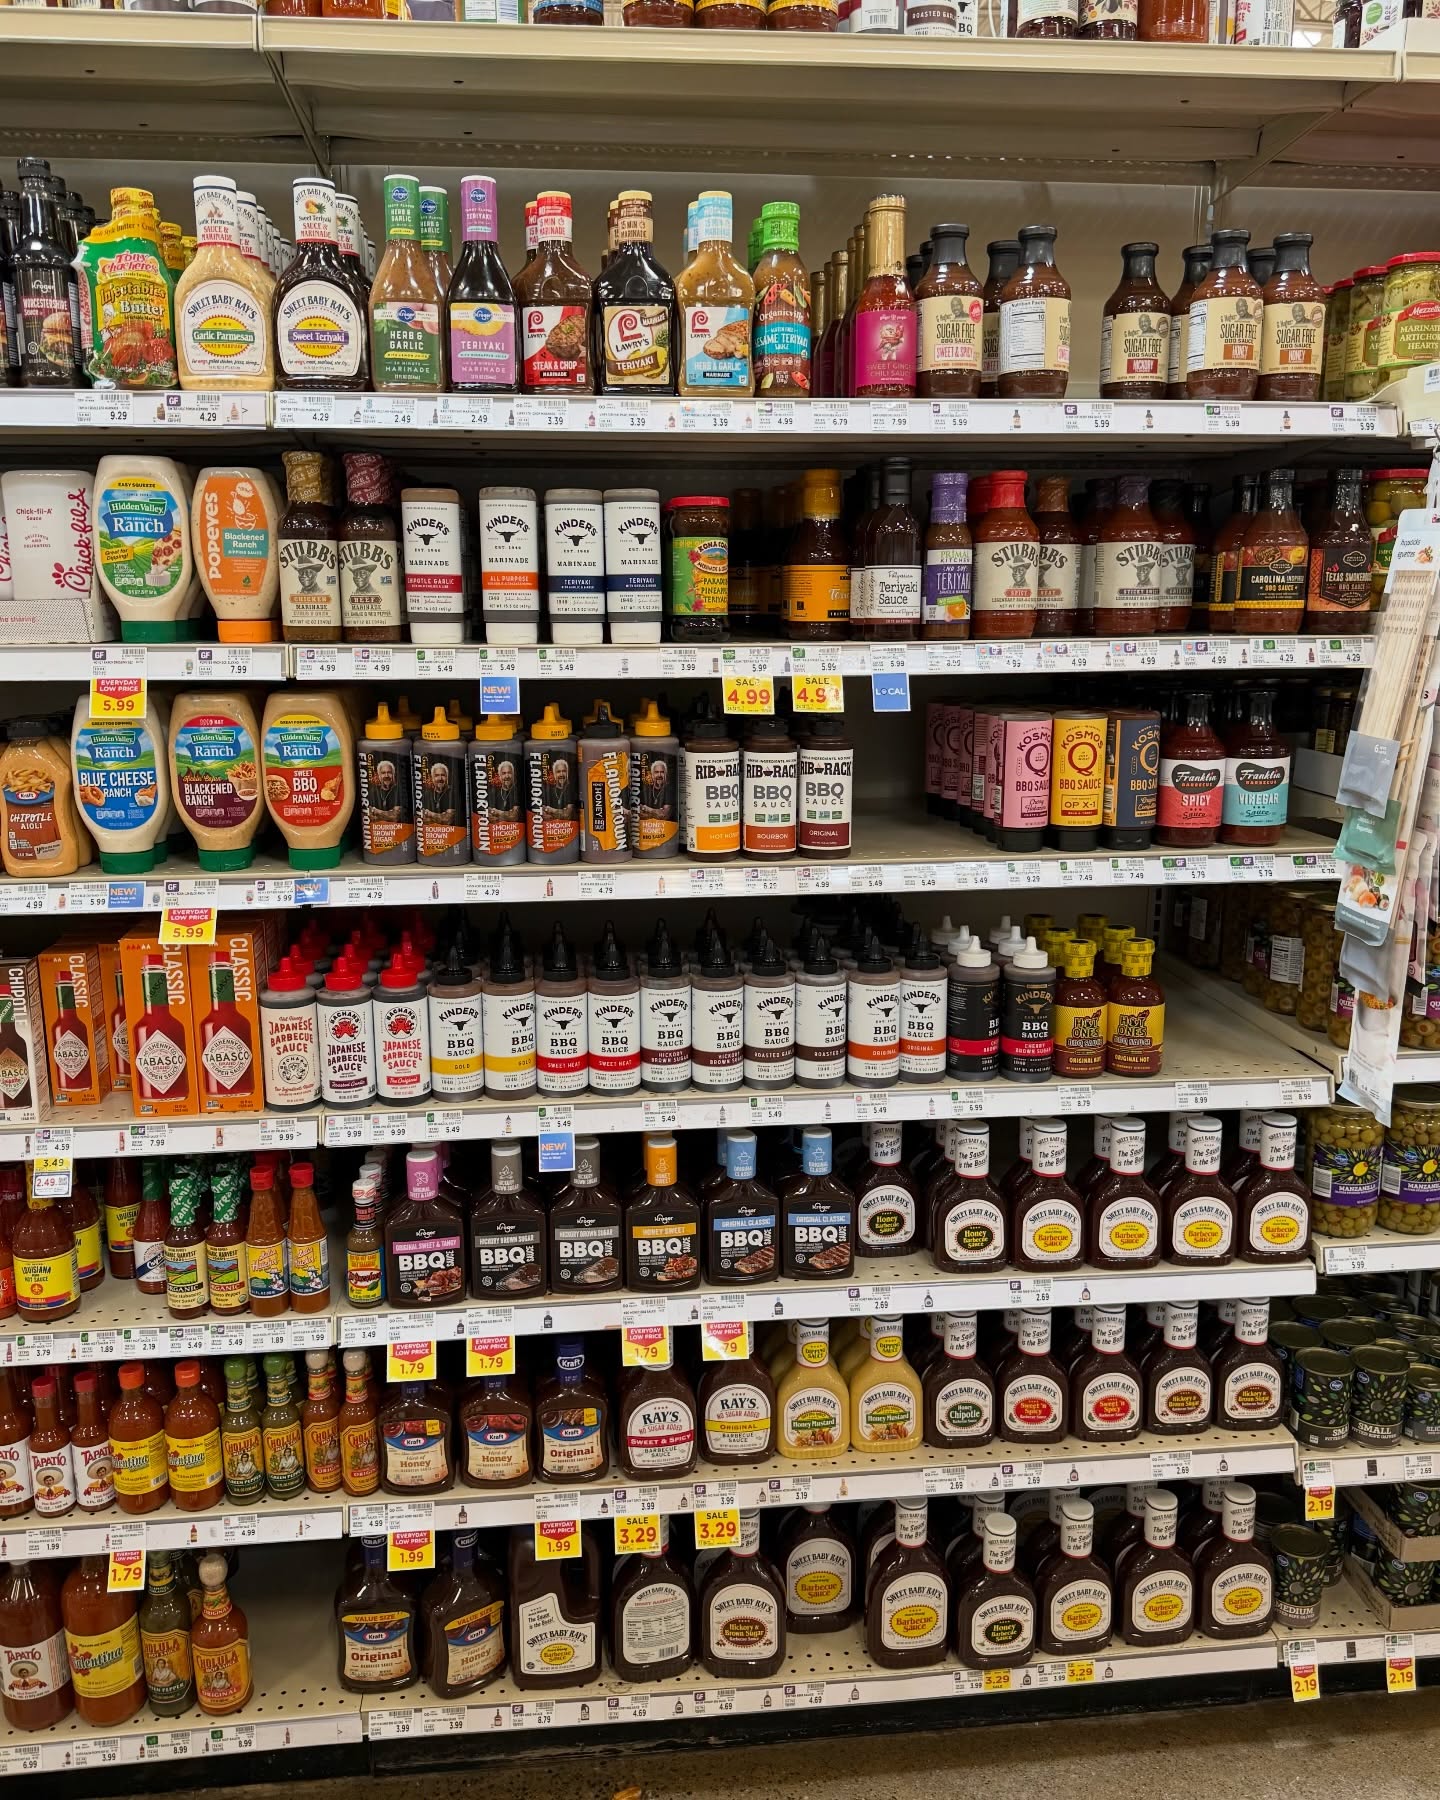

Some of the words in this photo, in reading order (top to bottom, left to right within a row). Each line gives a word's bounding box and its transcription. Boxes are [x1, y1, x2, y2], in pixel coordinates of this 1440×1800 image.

[912, 10, 943, 20] ROASTED
[100, 281, 167, 306] Injectables
[23, 298, 67, 310] WORCESTERSHIRE
[120, 301, 164, 316] Butter
[188, 297, 211, 319] SWEET
[212, 295, 234, 306] BABY
[233, 299, 256, 321] RAY'S
[284, 298, 306, 319] SWEET
[307, 295, 329, 306] BABY
[329, 299, 352, 321] RAY'S
[193, 331, 217, 341] Garlic
[218, 331, 254, 342] Parmesan
[390, 331, 414, 340] HERB
[416, 332, 423, 340] &
[936, 323, 960, 340] SUGAR
[961, 322, 976, 339] FREE
[293, 332, 313, 342] Sweet
[314, 331, 346, 343] Teriyaki
[390, 341, 424, 350] GARLIC
[460, 342, 505, 352] TERIYAKI
[615, 339, 650, 352] LAWRY'S
[1407, 341, 1438, 350] HEARTS
[533, 361, 552, 371] STEAK
[553, 361, 559, 370] &
[560, 361, 578, 371] CHOP
[615, 356, 655, 371] TERIYAKI
[694, 361, 714, 371] HERB
[721, 362, 742, 372] GARLIC
[385, 366, 430, 374] MARINADE
[462, 366, 506, 374] MARINADE
[110, 411, 127, 421] 9.29
[200, 412, 217, 422] 4.29
[394, 415, 411, 424] 2.49
[547, 416, 564, 425] 3.39
[1360, 422, 1375, 430] 5.99
[111, 501, 139, 514] Hidden
[139, 502, 165, 514] Valley
[113, 517, 165, 534] Ranch
[406, 517, 450, 536] KINDER'S
[485, 514, 529, 534] KINDER'S
[224, 532, 264, 541] Blackened
[233, 540, 257, 549] Ranch
[280, 541, 337, 569] STUBB'S
[488, 556, 529, 564] MARINADE
[409, 559, 449, 567] MARINADE
[1251, 575, 1286, 584] CAROLINA
[1325, 571, 1344, 582] TEXAS
[880, 581, 918, 597] Teriyaki
[879, 593, 908, 605] Sauce
[1280, 653, 1294, 662] 4.29
[230, 665, 247, 674] 7.99
[805, 677, 830, 685] SALE
[483, 685, 511, 695] NEW!
[876, 687, 906, 696] LOCAL
[727, 689, 770, 705] 4.99
[103, 700, 135, 712] 5.99
[92, 733, 113, 744] Hidden
[114, 732, 133, 744] Valley
[95, 746, 135, 758] Ranch
[1068, 742, 1097, 776] Q
[293, 769, 313, 777] SWEET
[800, 761, 815, 776] RIB
[823, 761, 852, 777] RACK
[80, 771, 107, 787] BLUE
[109, 770, 156, 786] CHEESE
[1176, 770, 1217, 783] Franklin
[184, 782, 232, 795] BLACKENED
[292, 776, 318, 792] BBQ
[805, 781, 844, 797] BBQ
[1060, 779, 1075, 790] BBQ
[1077, 778, 1101, 790] SAUCE
[104, 786, 132, 798] RANCH
[185, 793, 214, 806] RANCH
[292, 793, 320, 804] RANCH
[805, 797, 844, 806] SAUCE
[1182, 795, 1210, 806] SPICY
[1239, 793, 1279, 805] VINEGAR
[1064, 801, 1079, 809] OP
[1082, 801, 1096, 809] X-1
[10, 812, 53, 824] CHIPOTLE
[20, 821, 43, 830] AIOLI
[757, 832, 788, 840] BOURBON
[809, 829, 838, 837] ORIGINAL
[1192, 870, 1206, 879] 5.79
[367, 891, 382, 900] 4.79
[26, 900, 43, 909] 4.99
[173, 927, 204, 938] 5.99
[229, 937, 252, 1002] CLASSIC
[438, 1006, 479, 1022] KINDER'S
[595, 1005, 635, 1018] KINDER'S
[268, 1017, 312, 1036] JAPANESE
[907, 1020, 934, 1031] BBQ
[270, 1033, 313, 1048] BARBECUE
[447, 1037, 474, 1048] BBQ
[601, 1036, 628, 1046] BBQ
[276, 1043, 308, 1056] SAUCE
[447, 1048, 475, 1057] SAUCE
[907, 1044, 933, 1052] ORIGINAL
[138, 1055, 184, 1067] TABASCO
[204, 1051, 250, 1062] TABASCO
[969, 1104, 983, 1112] 6.99
[661, 1114, 676, 1122] 5.49
[150, 1139, 165, 1147] 7.99
[43, 1158, 64, 1168] 3.49
[795, 1226, 839, 1243] BBQ
[965, 1230, 987, 1239] Honey
[1038, 1234, 1069, 1242] Barbecue
[638, 1238, 682, 1256] BBQ
[1044, 1240, 1063, 1248] Sauce
[400, 1252, 446, 1271] BBQ
[480, 1247, 526, 1265] BBQ
[21, 1264, 52, 1275] LOUISIANA
[1351, 1260, 1365, 1269] 5.99
[875, 1301, 889, 1310] 2.69
[400, 1363, 425, 1375] 1.79
[720, 1397, 757, 1410] RAY'S
[949, 1409, 980, 1419] Chipotle
[793, 1420, 813, 1430] Honey
[814, 1419, 836, 1428] Mustard
[1357, 1422, 1392, 1435] SMALL
[550, 1446, 595, 1459] Original
[482, 1454, 512, 1465] Honey
[1307, 1499, 1333, 1512] 2.19
[706, 1511, 728, 1519] SALE
[619, 1527, 657, 1544] 3.29
[800, 1583, 838, 1592] Barbecue
[808, 1589, 831, 1598] Sauce
[351, 1649, 402, 1663] Original
[1294, 1679, 1317, 1692] 2.19
[396, 1724, 410, 1733] 3.99
